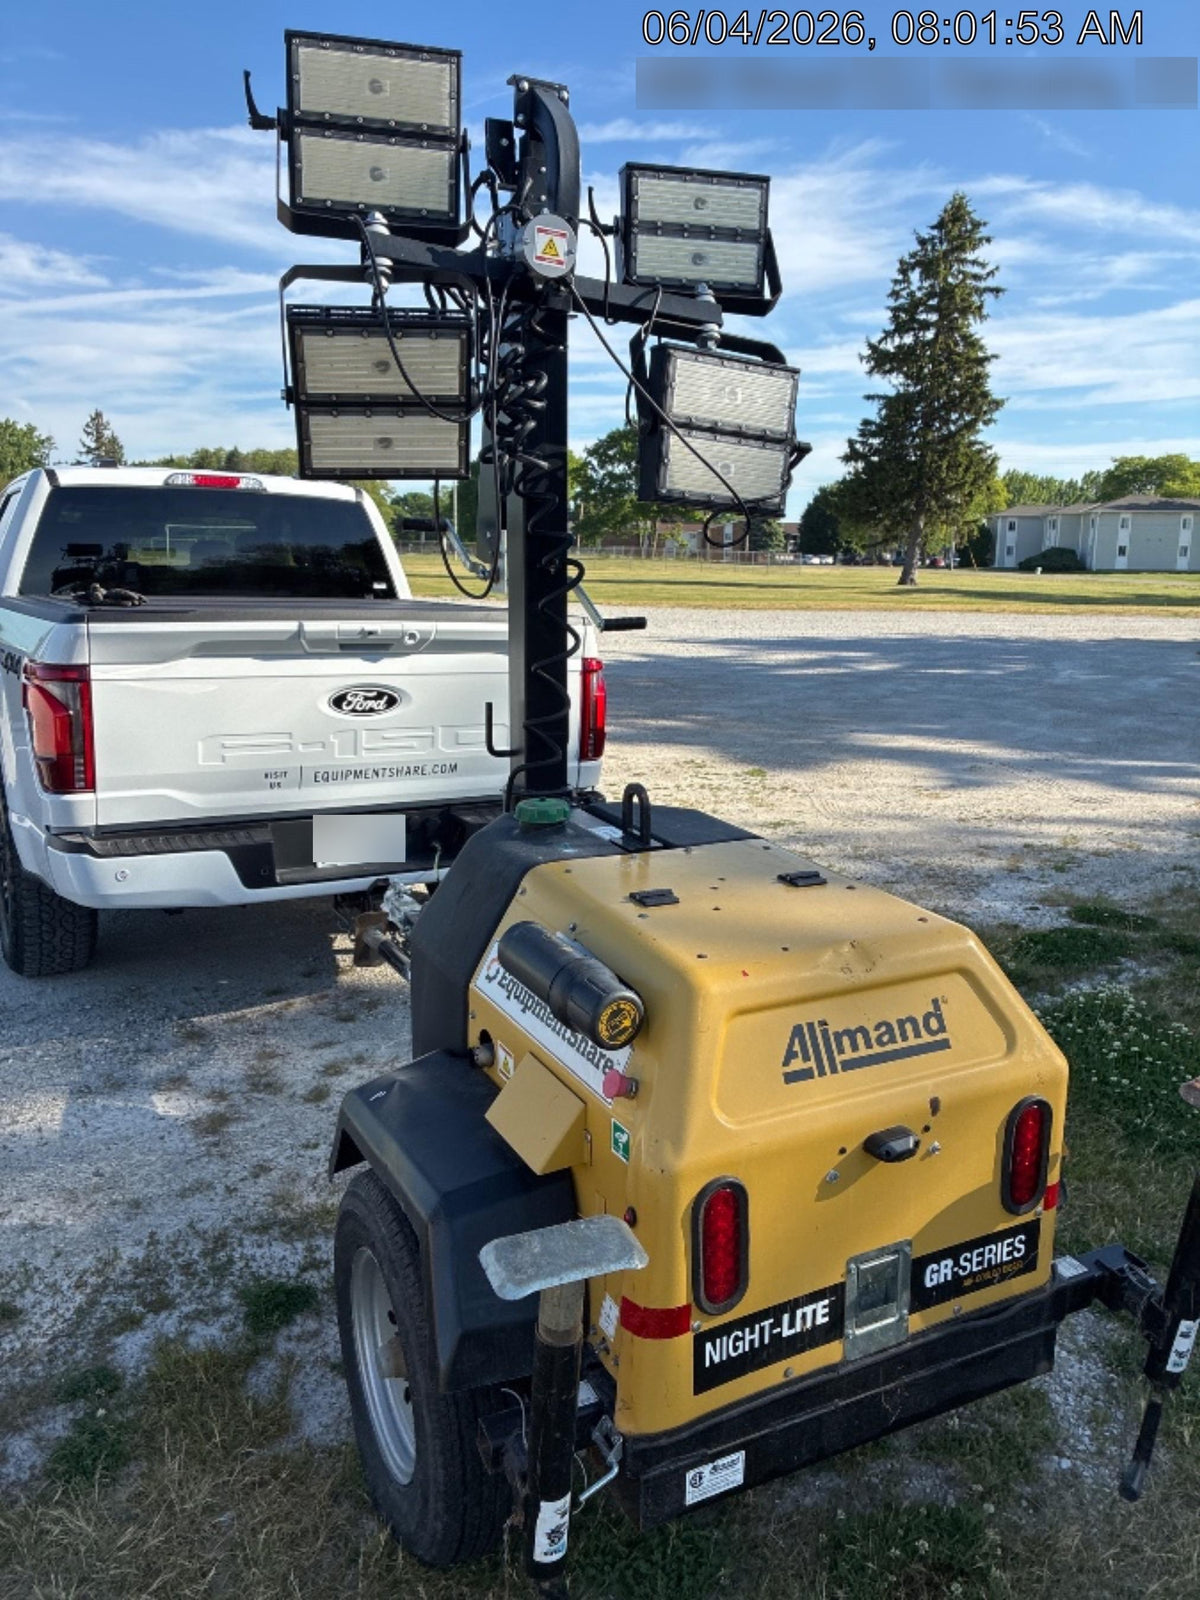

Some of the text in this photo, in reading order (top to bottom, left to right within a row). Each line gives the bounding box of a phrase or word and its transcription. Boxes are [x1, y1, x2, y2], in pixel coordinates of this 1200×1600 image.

[341, 690, 389, 712] Ford
[197, 723, 511, 766] F-150
[264, 770, 288, 780] VISIT
[313, 762, 458, 784] EQUIPMENTSHARE.COM
[269, 781, 282, 790] US
[923, 1234, 1026, 1289] GR-SERIES
[704, 1298, 830, 1368] NIGHT-LITE
